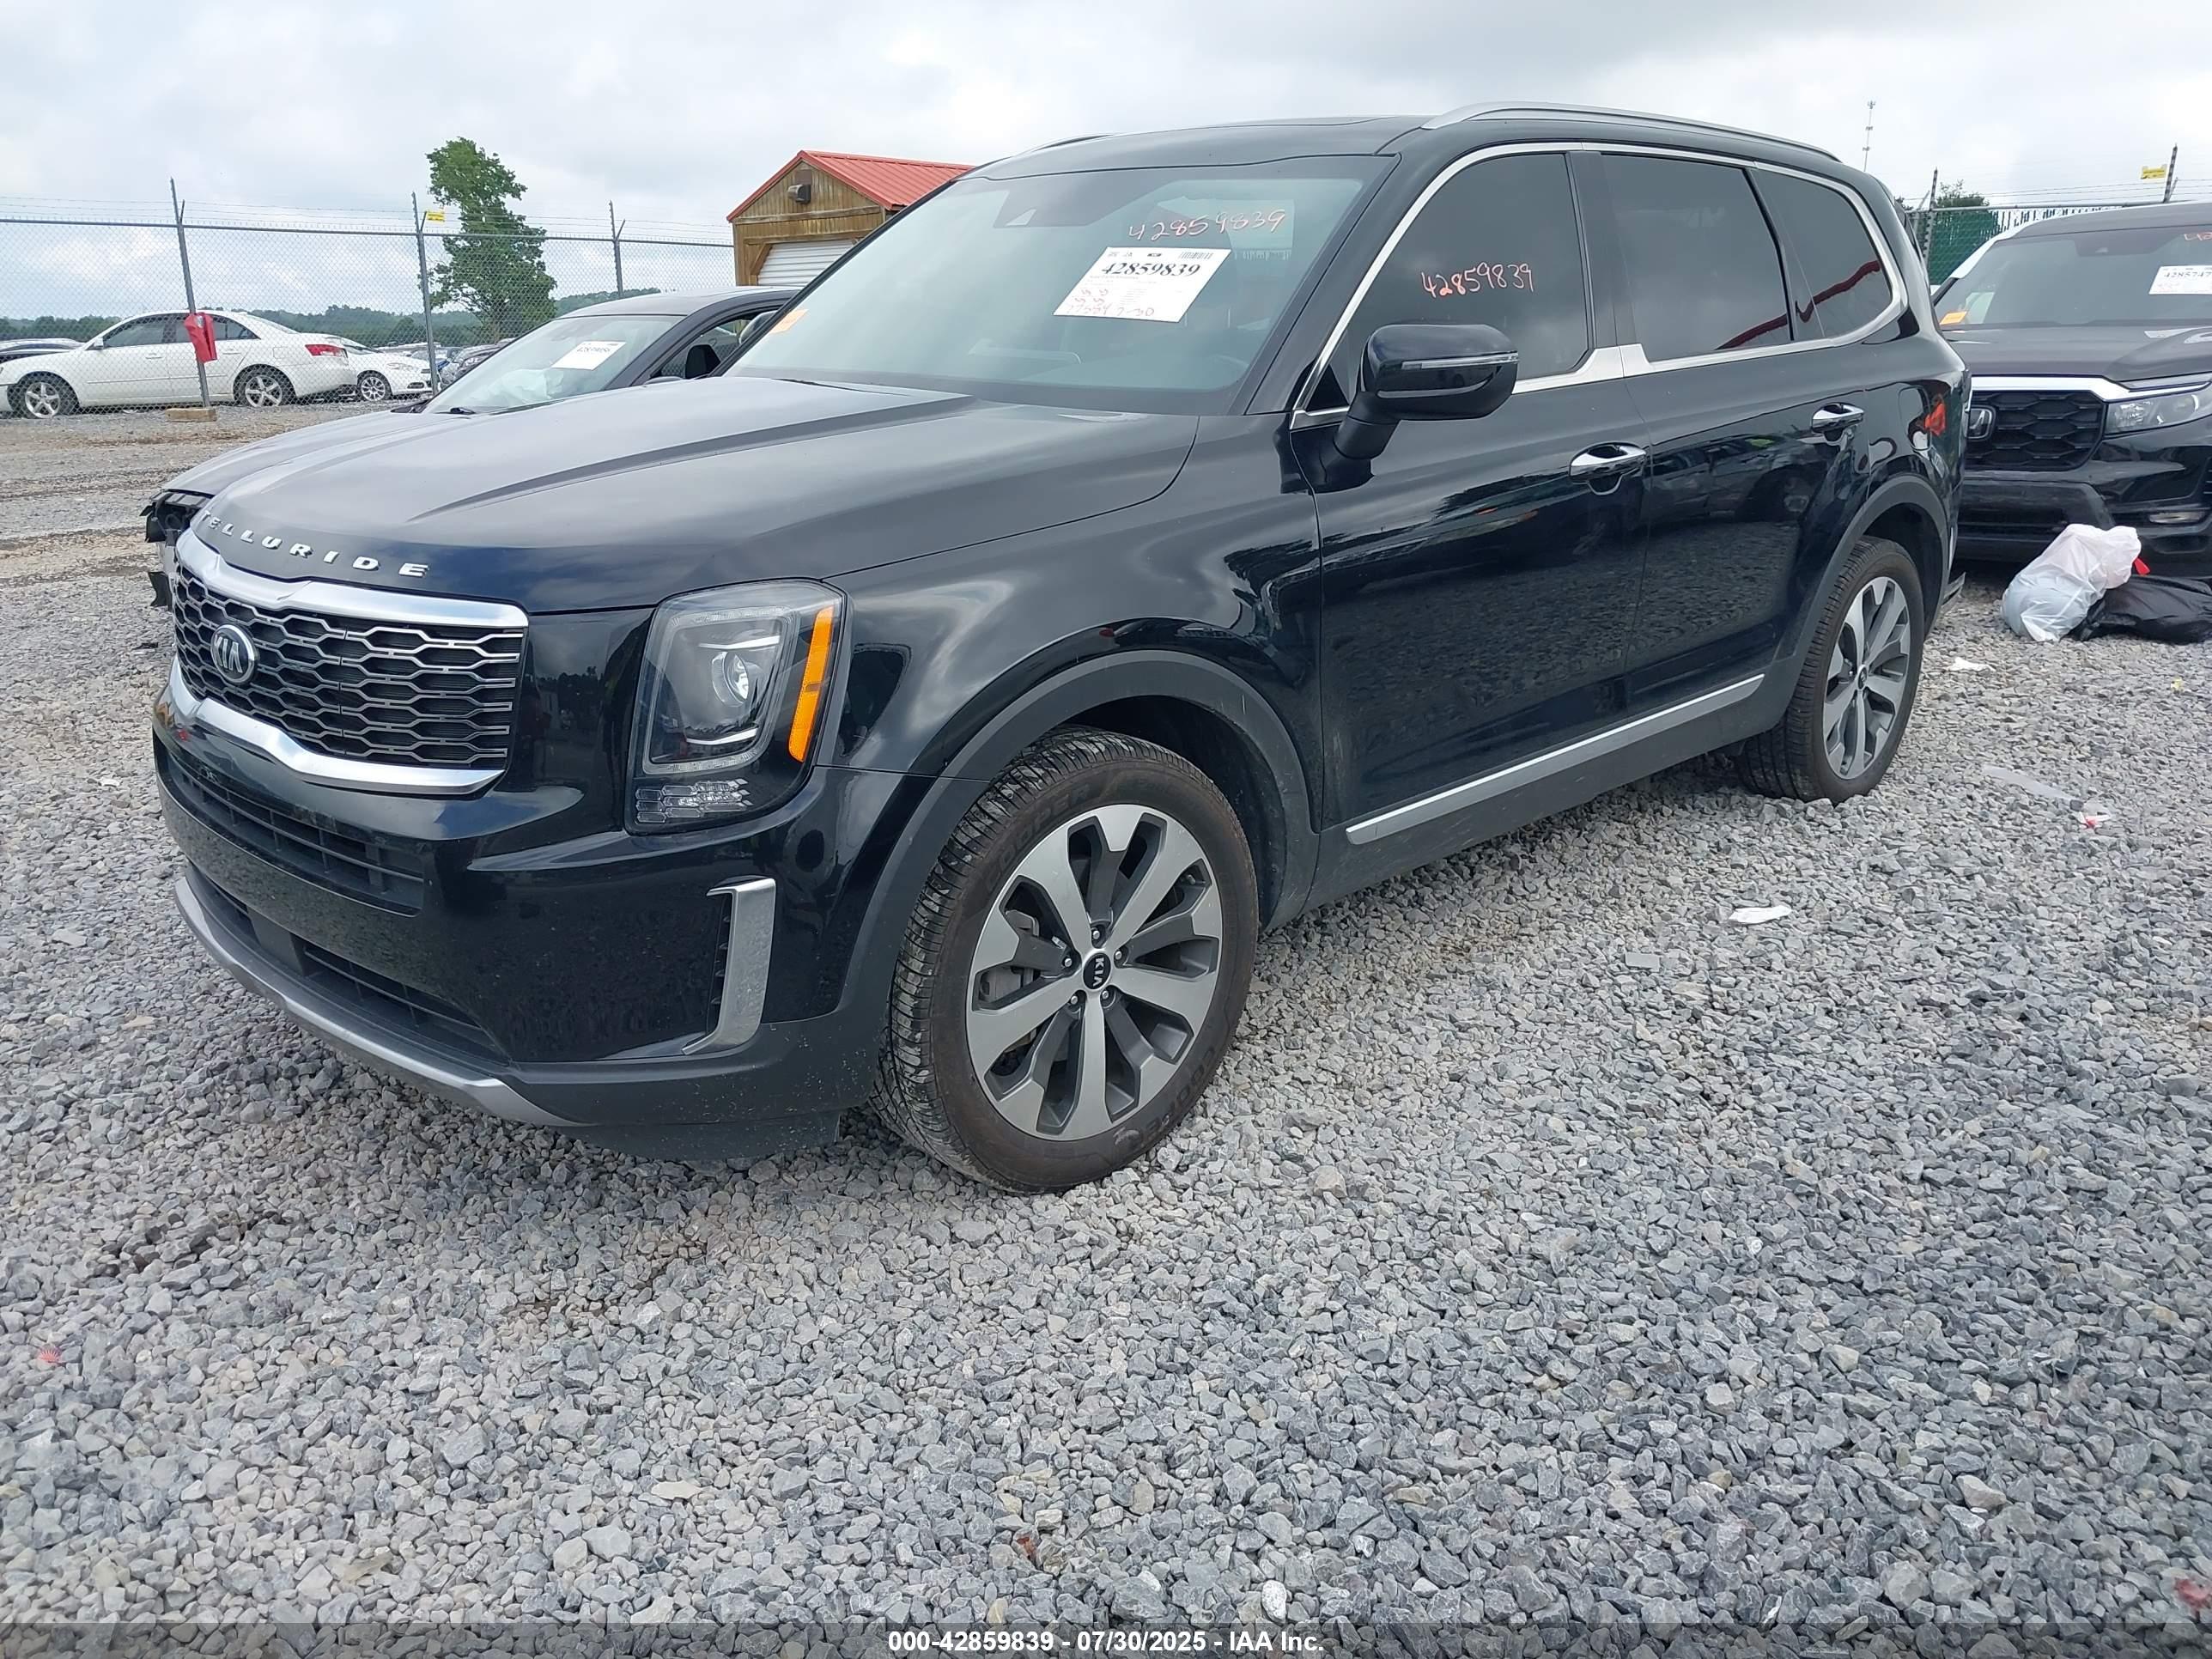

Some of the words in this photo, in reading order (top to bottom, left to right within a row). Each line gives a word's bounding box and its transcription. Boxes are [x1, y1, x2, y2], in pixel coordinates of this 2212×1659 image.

[1128, 209, 1285, 241] 42859839
[1101, 262, 1201, 276] 42859839
[1421, 262, 1534, 298] 42859839
[203, 510, 428, 578] TELLURIDE
[1092, 957, 1105, 988] KIA
